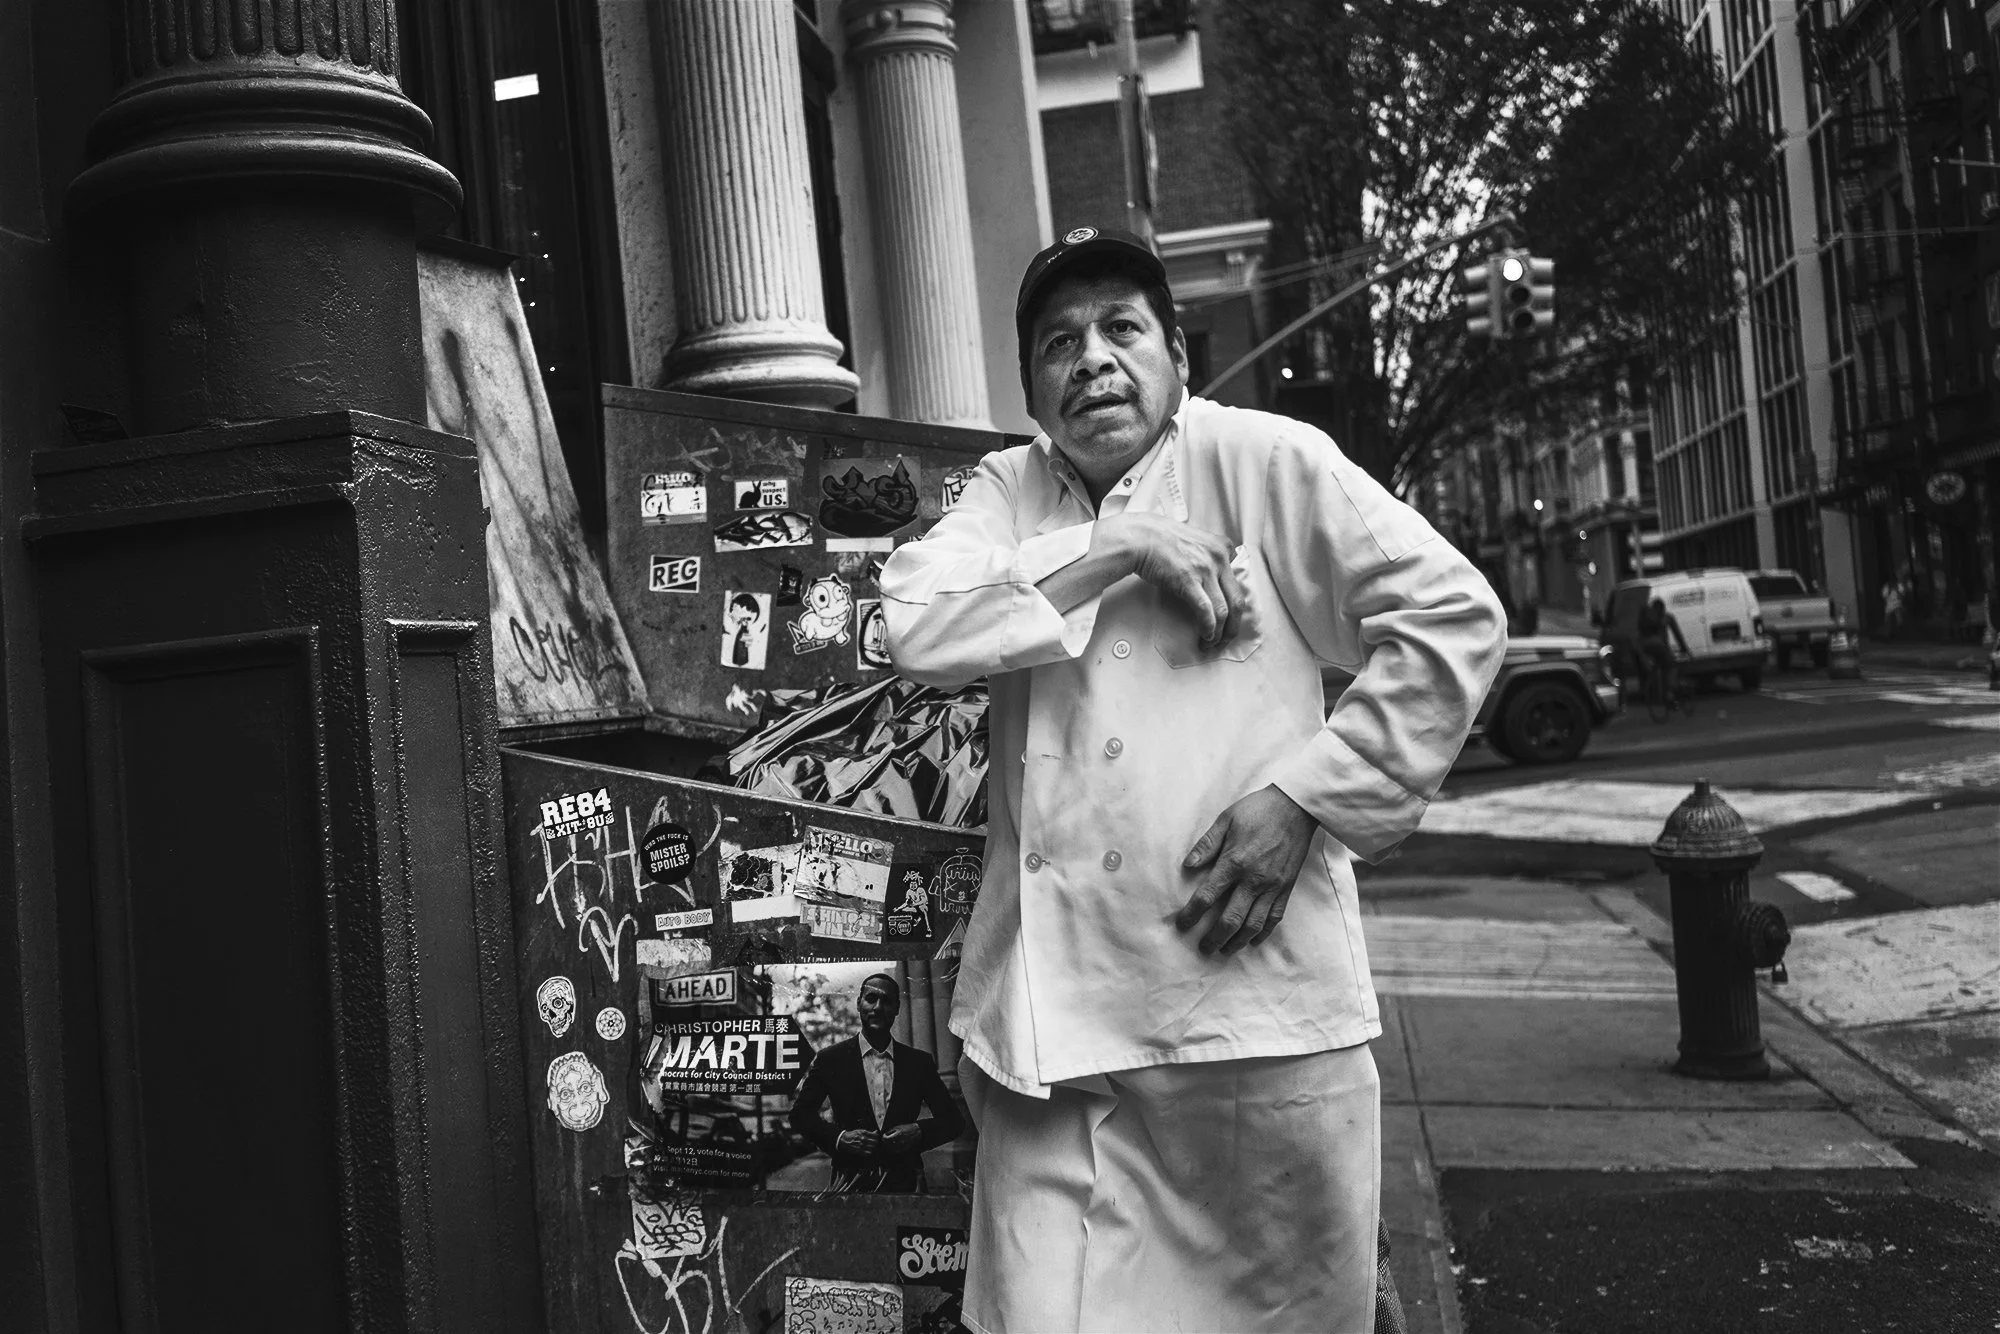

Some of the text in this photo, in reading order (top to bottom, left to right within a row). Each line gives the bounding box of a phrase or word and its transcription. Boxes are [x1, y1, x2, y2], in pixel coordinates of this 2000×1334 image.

[653, 559, 698, 587] REG
[540, 787, 612, 827] RE84
[650, 842, 687, 862] MISTER
[650, 853, 690, 873] SPOILS?
[658, 912, 710, 927] AUTO BODY
[664, 977, 727, 999] AHEAD
[654, 1019, 761, 1034] CHRISTOPHER
[690, 1070, 702, 1079] for
[704, 1070, 720, 1080] City
[722, 1071, 753, 1080] Council
[755, 1072, 785, 1080] District
[697, 1148, 713, 1156] vote
[714, 1149, 725, 1157] for
